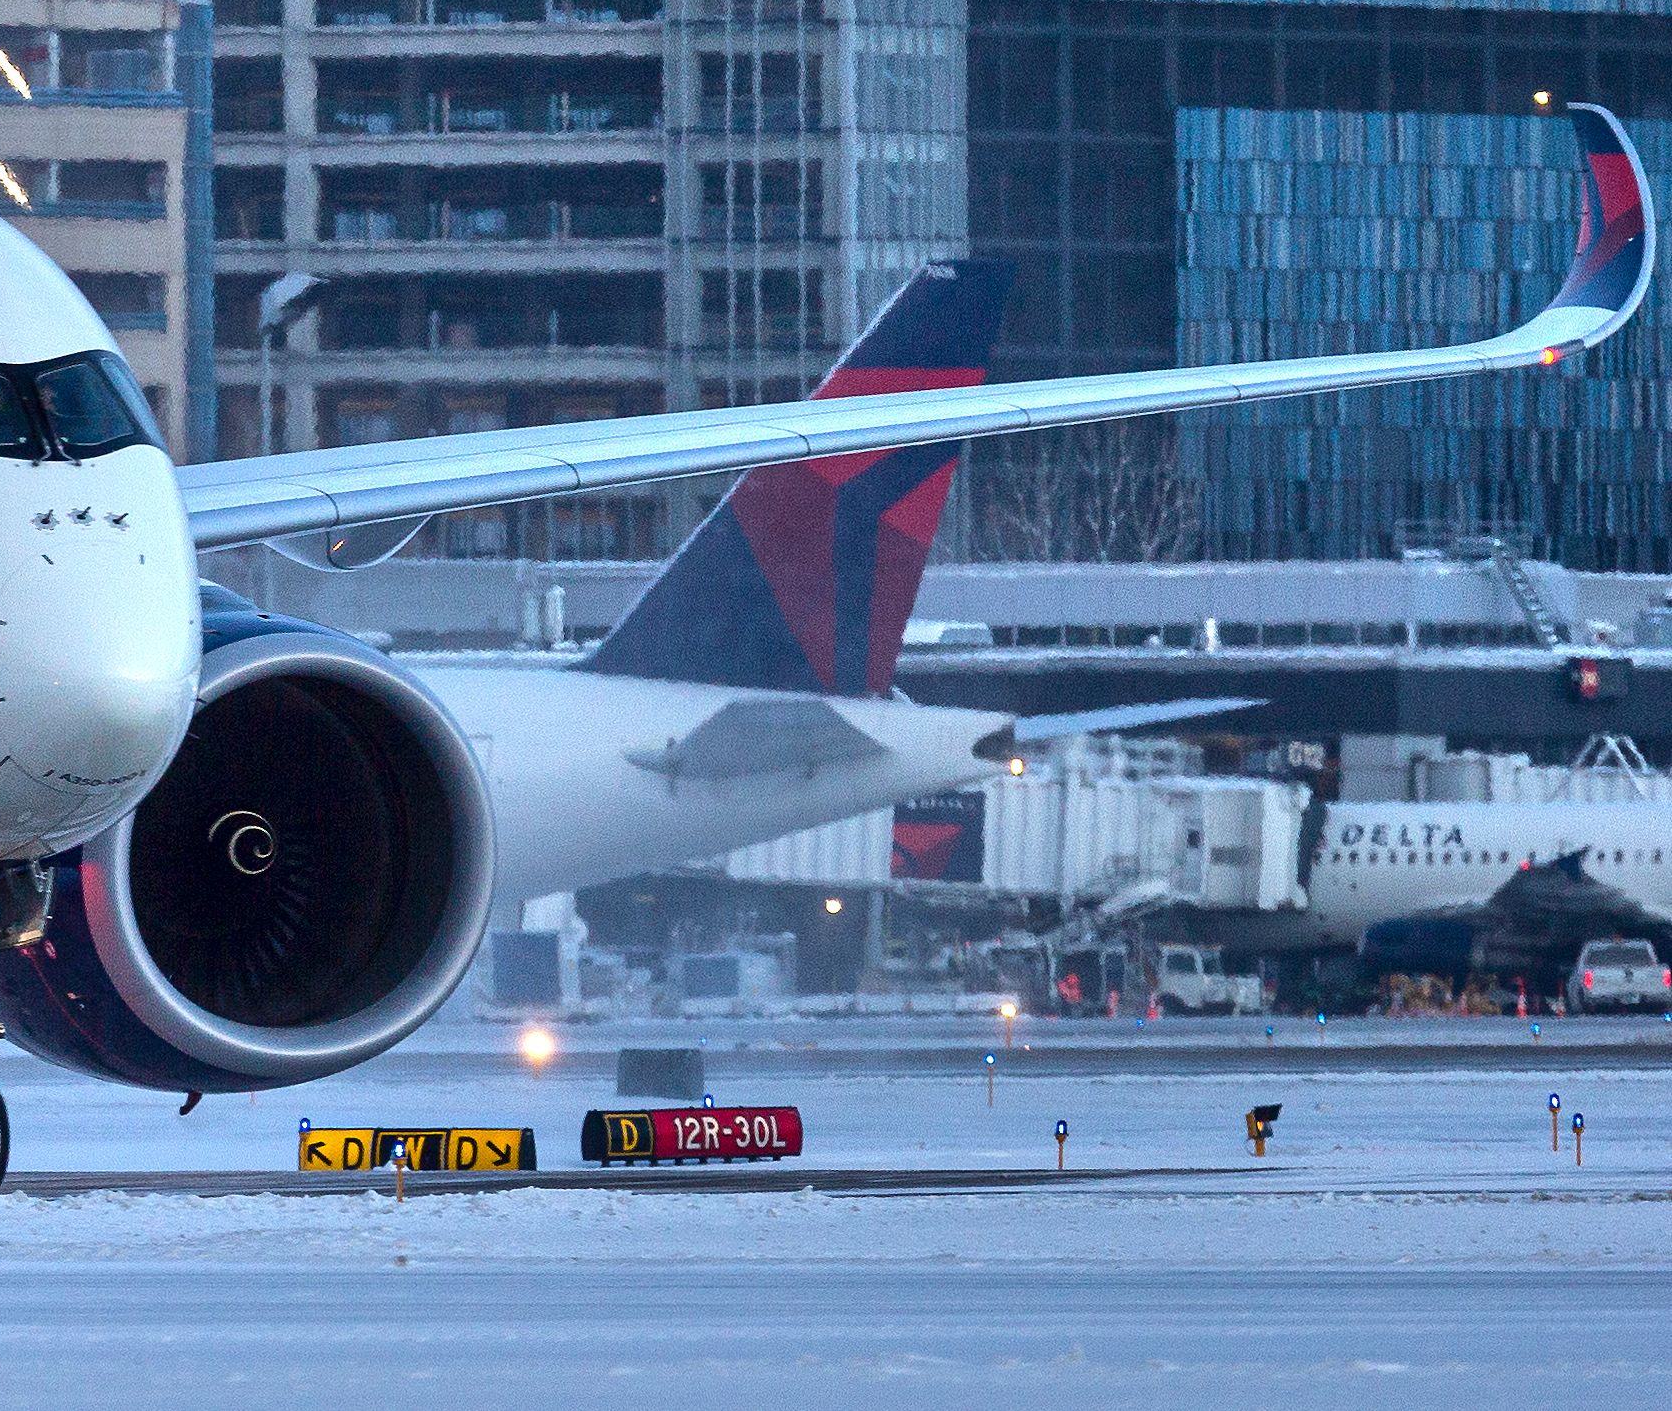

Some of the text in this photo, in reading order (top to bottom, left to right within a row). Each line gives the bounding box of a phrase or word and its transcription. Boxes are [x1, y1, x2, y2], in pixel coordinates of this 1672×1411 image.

[1341, 822, 1465, 848] DELTA
[620, 1114, 787, 1152] D 12R-30L
[343, 1137, 365, 1171] D
[457, 1136, 479, 1170] D
